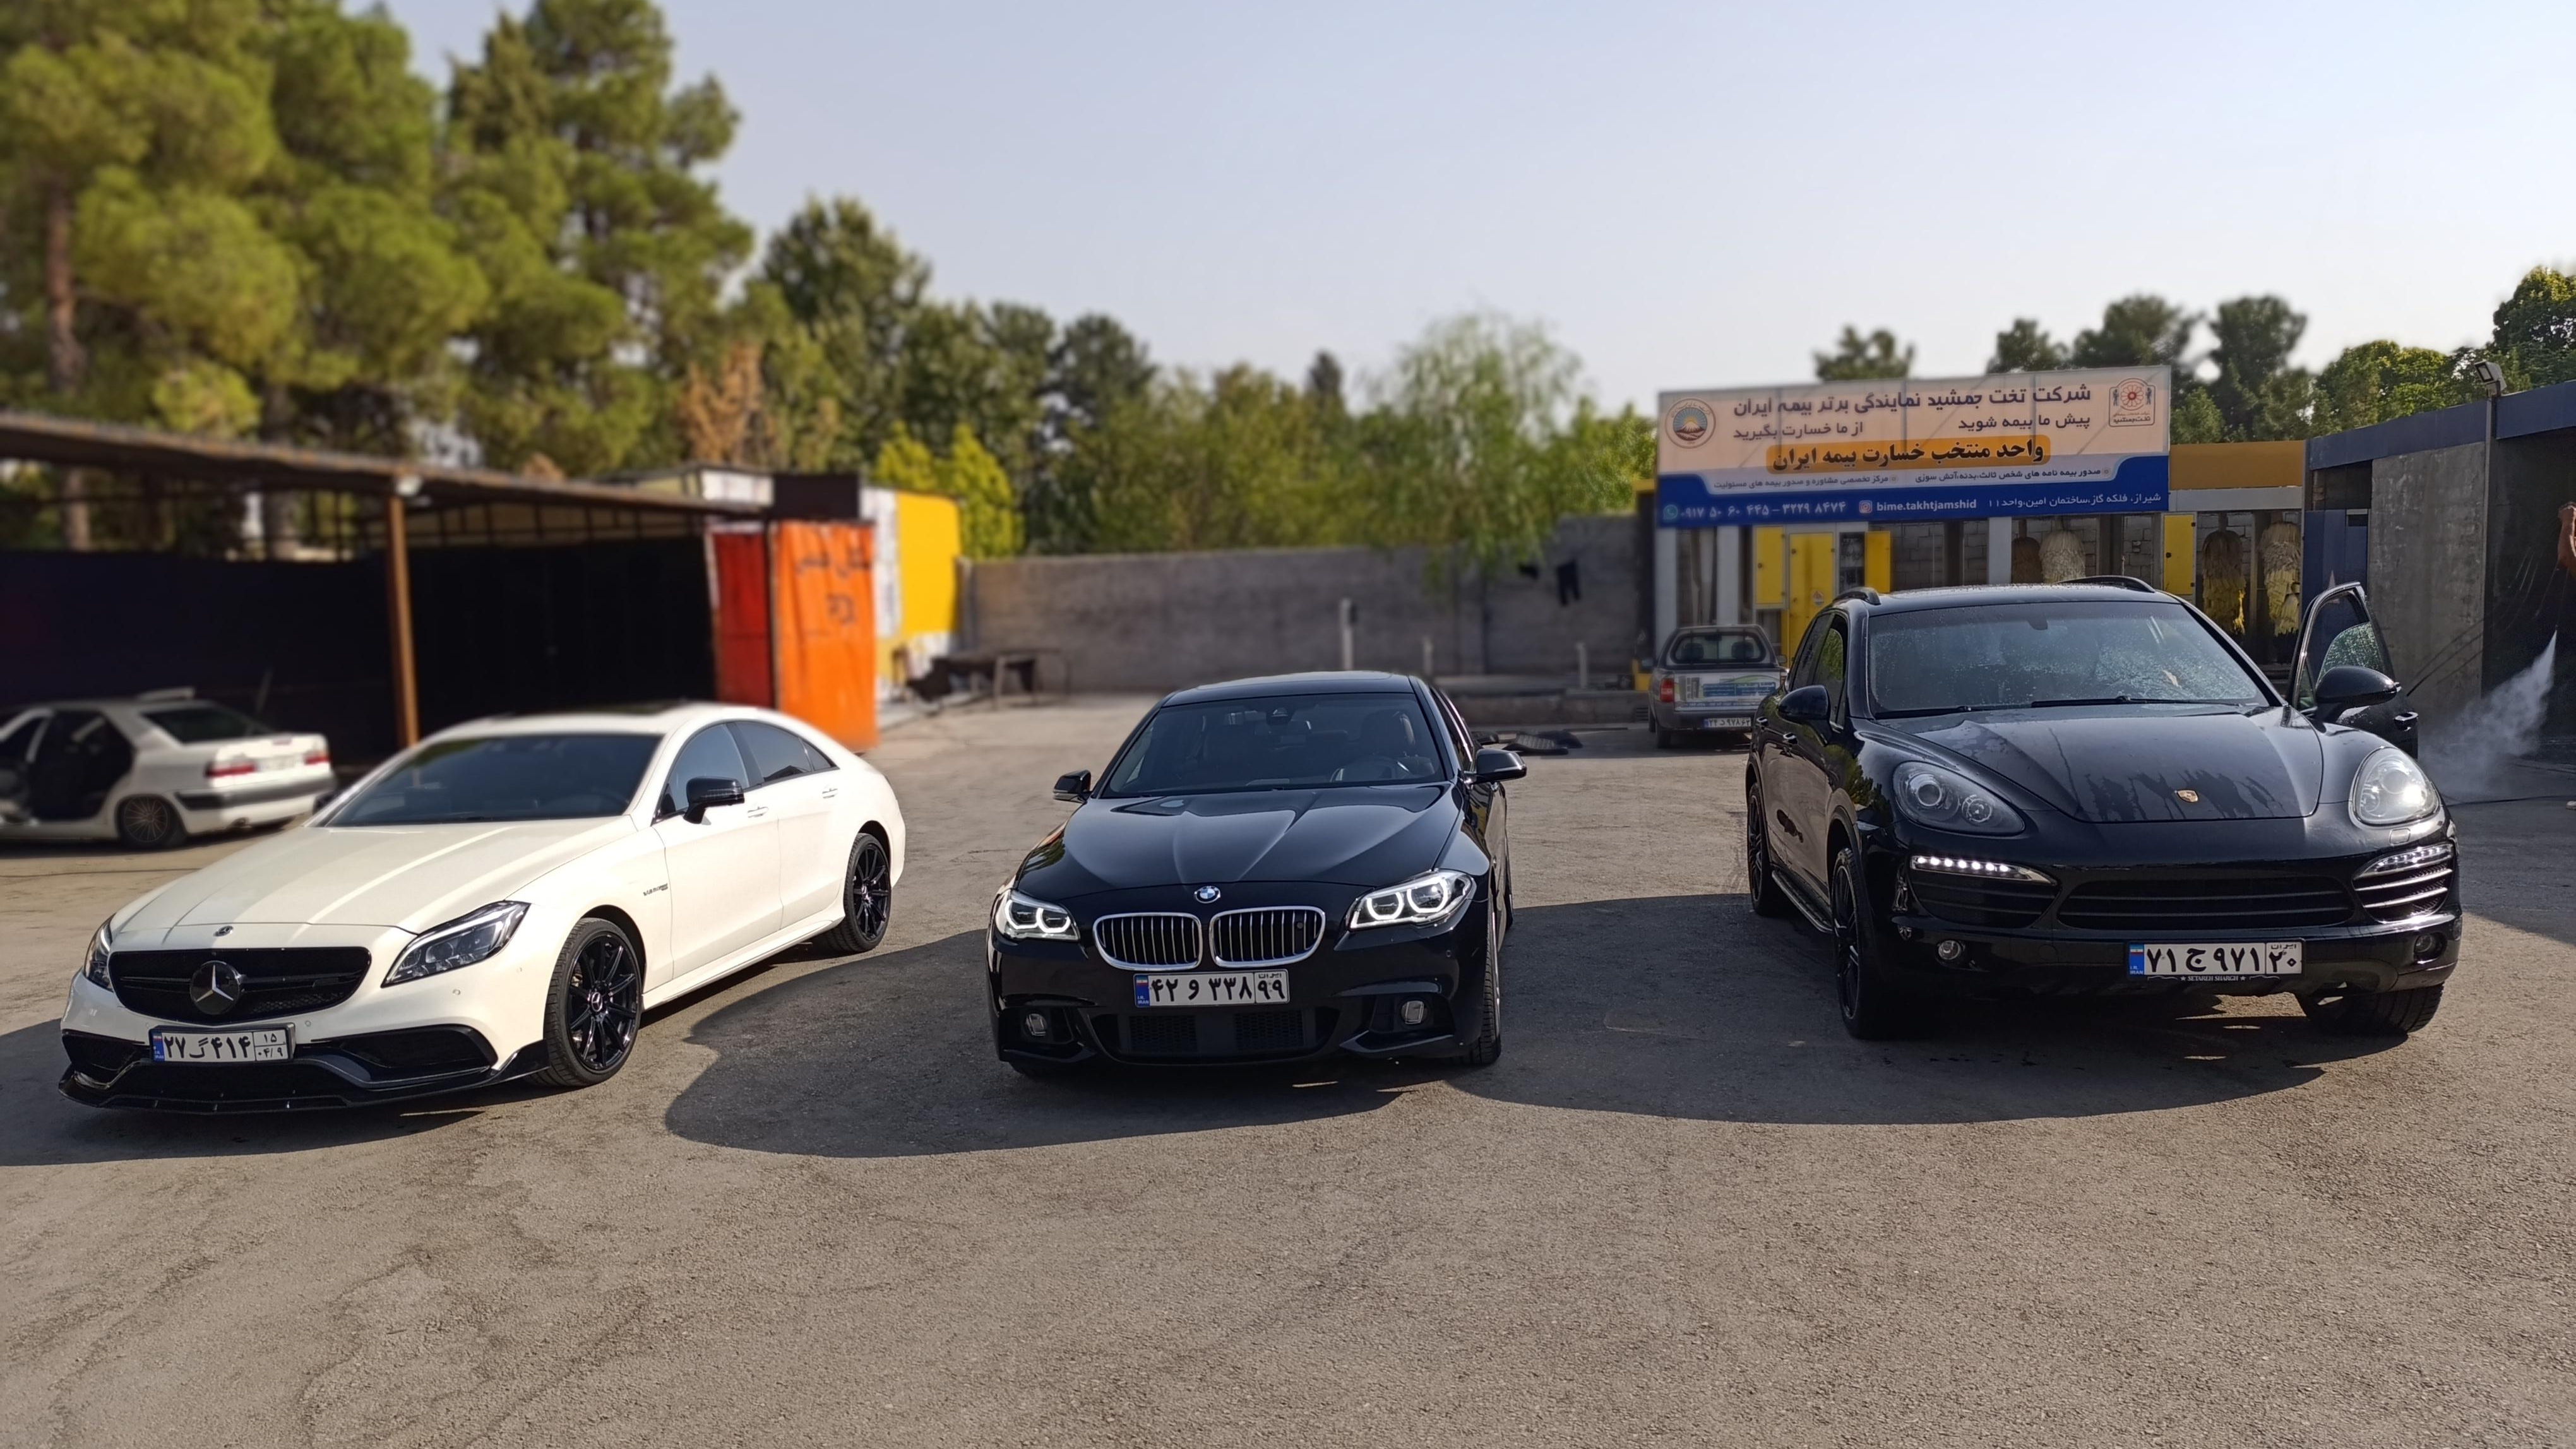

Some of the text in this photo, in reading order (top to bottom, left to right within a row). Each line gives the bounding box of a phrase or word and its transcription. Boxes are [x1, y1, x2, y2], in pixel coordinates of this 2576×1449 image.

[1928, 389, 1983, 410] جمشید
[1989, 388, 2027, 403] تخت
[2032, 383, 2090, 403] شرکت
[1734, 397, 1772, 417] ایران
[1777, 399, 1812, 415] بیمه
[1817, 396, 1849, 414] برتر
[1854, 391, 1921, 414] نمایندگی
[1959, 413, 2090, 432] پیش ما بیمه شوید
[1733, 421, 1863, 441] از ما خسارت بگیرید
[1773, 439, 2044, 471] واحد منتخب خسارت بیمه ایران
[1871, 475, 1888, 484] مرکز
[1915, 474, 1937, 484] سوزی
[1998, 470, 2022, 480] شخص
[2024, 470, 2040, 480] های
[2041, 469, 2058, 477] نامه
[2060, 469, 2077, 477] بیمه
[2078, 468, 2101, 477] صدور
[1748, 479, 1763, 489] های
[1781, 479, 1804, 488] صدور
[1812, 477, 1839, 486] مشاوره
[1840, 476, 1871, 486] تخصصی
[2106, 492, 2128, 503] فلکه
[1680, 507, 1704, 518] ۰۹۱۷
[1709, 507, 1722, 518] ۵۰
[1727, 506, 1740, 517] ۶۰
[1814, 501, 1847, 513] ۸۴۷۴
[1876, 499, 1977, 512] bime.takhtjamshid
[2147, 947, 2260, 972] ۷۱ ج ۹۷۱
[2269, 951, 2297, 972] ۲۰
[1151, 976, 1253, 1001] ۴۲ و ۳۳۸
[1257, 979, 1285, 1000] ۹۹
[264, 1033, 277, 1043] ۱۵
[164, 1035, 186, 1059] ۲۷
[210, 1035, 251, 1059] ۴۱۴
